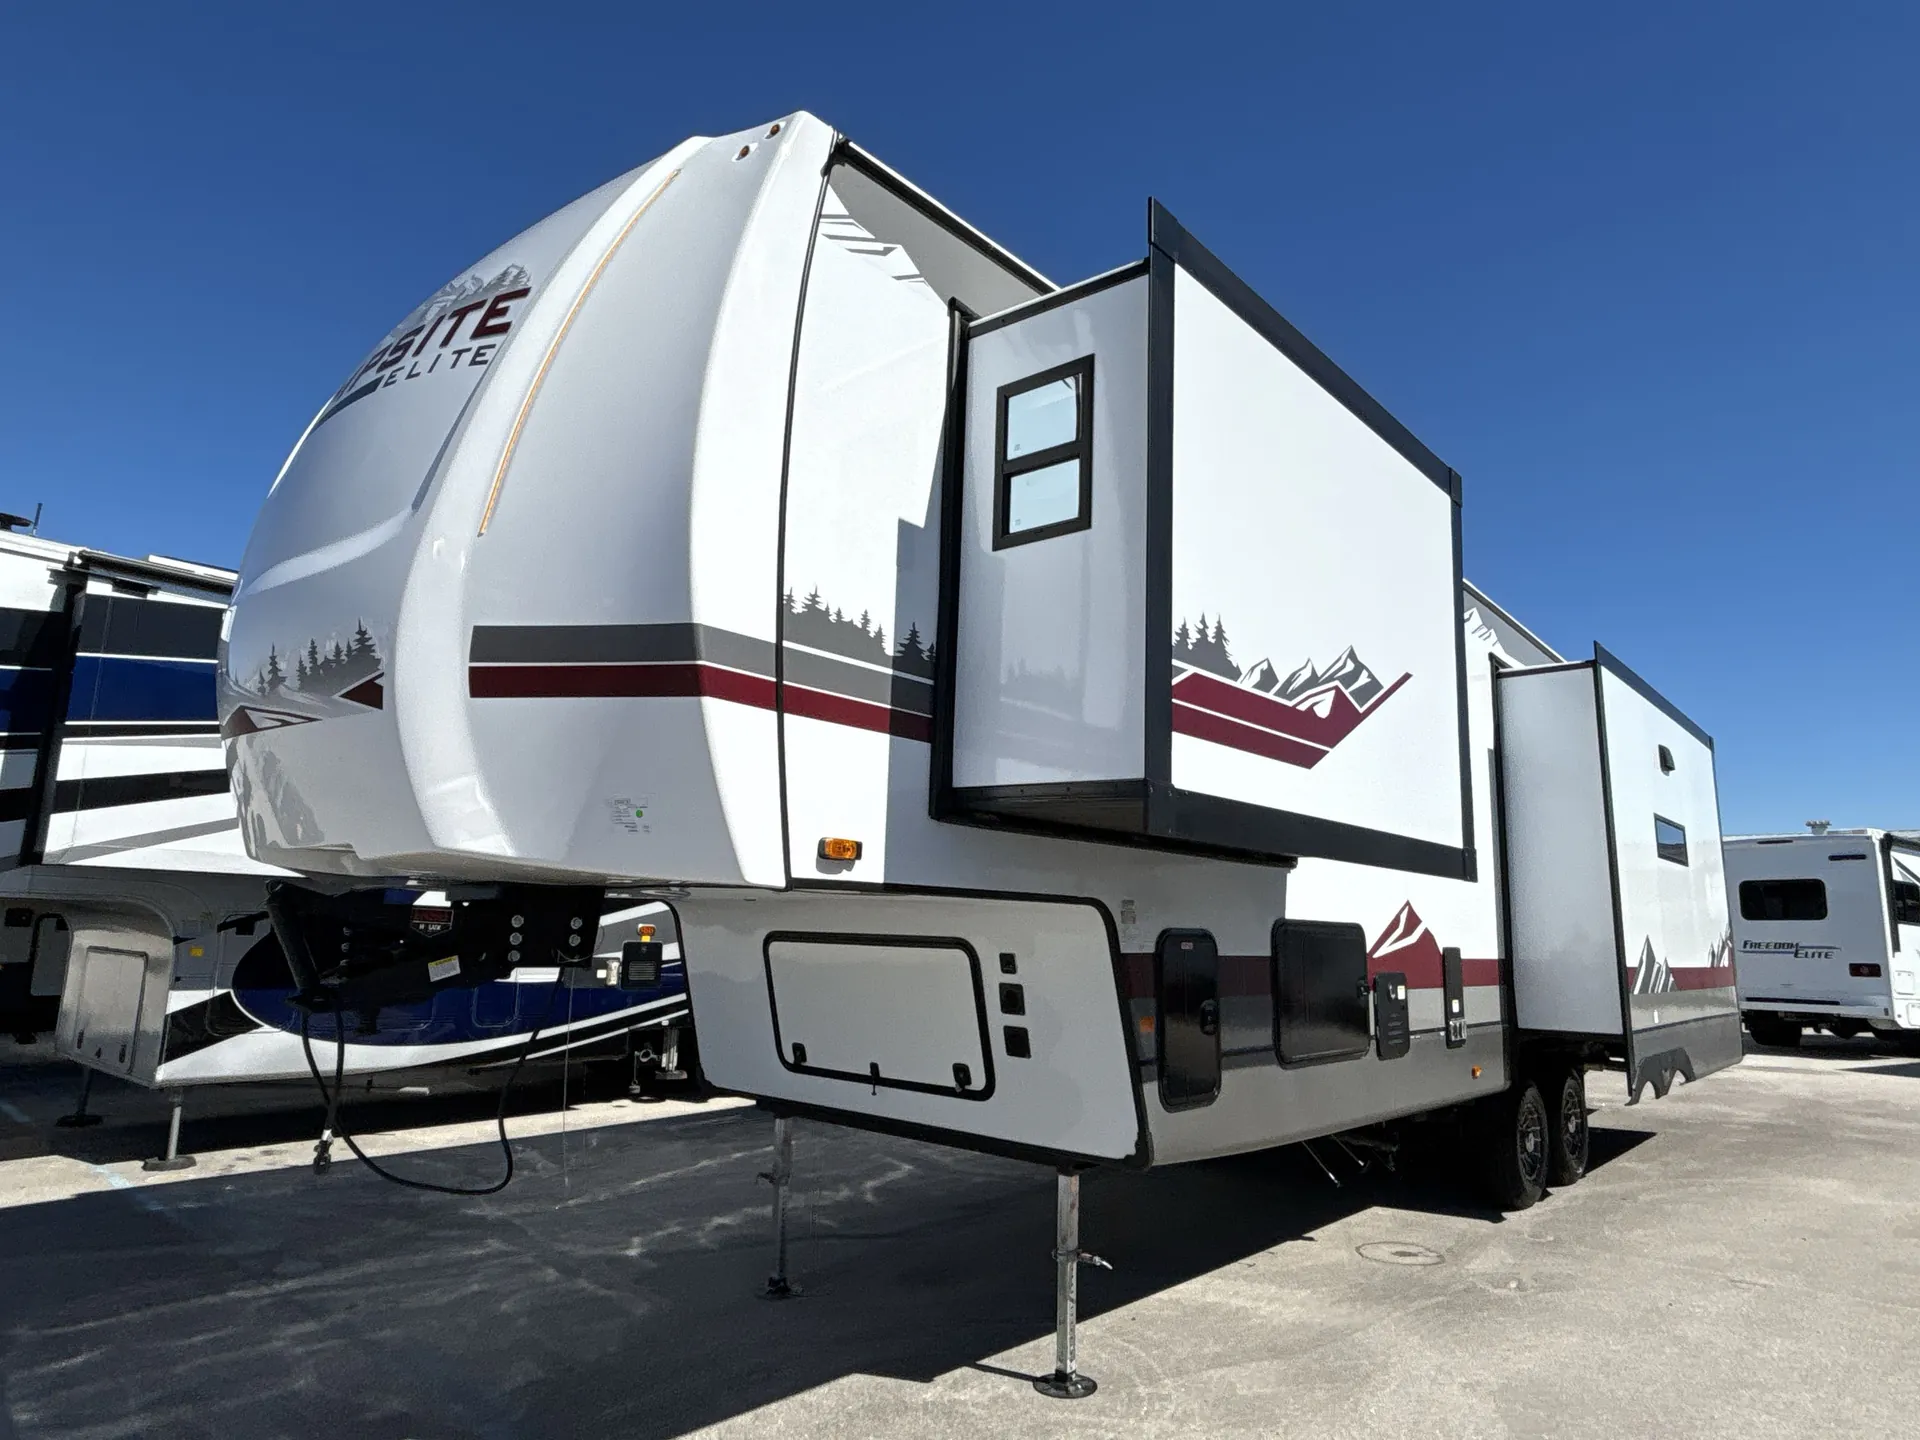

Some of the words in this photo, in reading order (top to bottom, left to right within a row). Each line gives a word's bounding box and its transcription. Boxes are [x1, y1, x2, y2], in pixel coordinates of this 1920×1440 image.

[336, 286, 532, 400] PSITE
[382, 343, 497, 389] ELITE
[1794, 949, 1834, 959] ELITE
